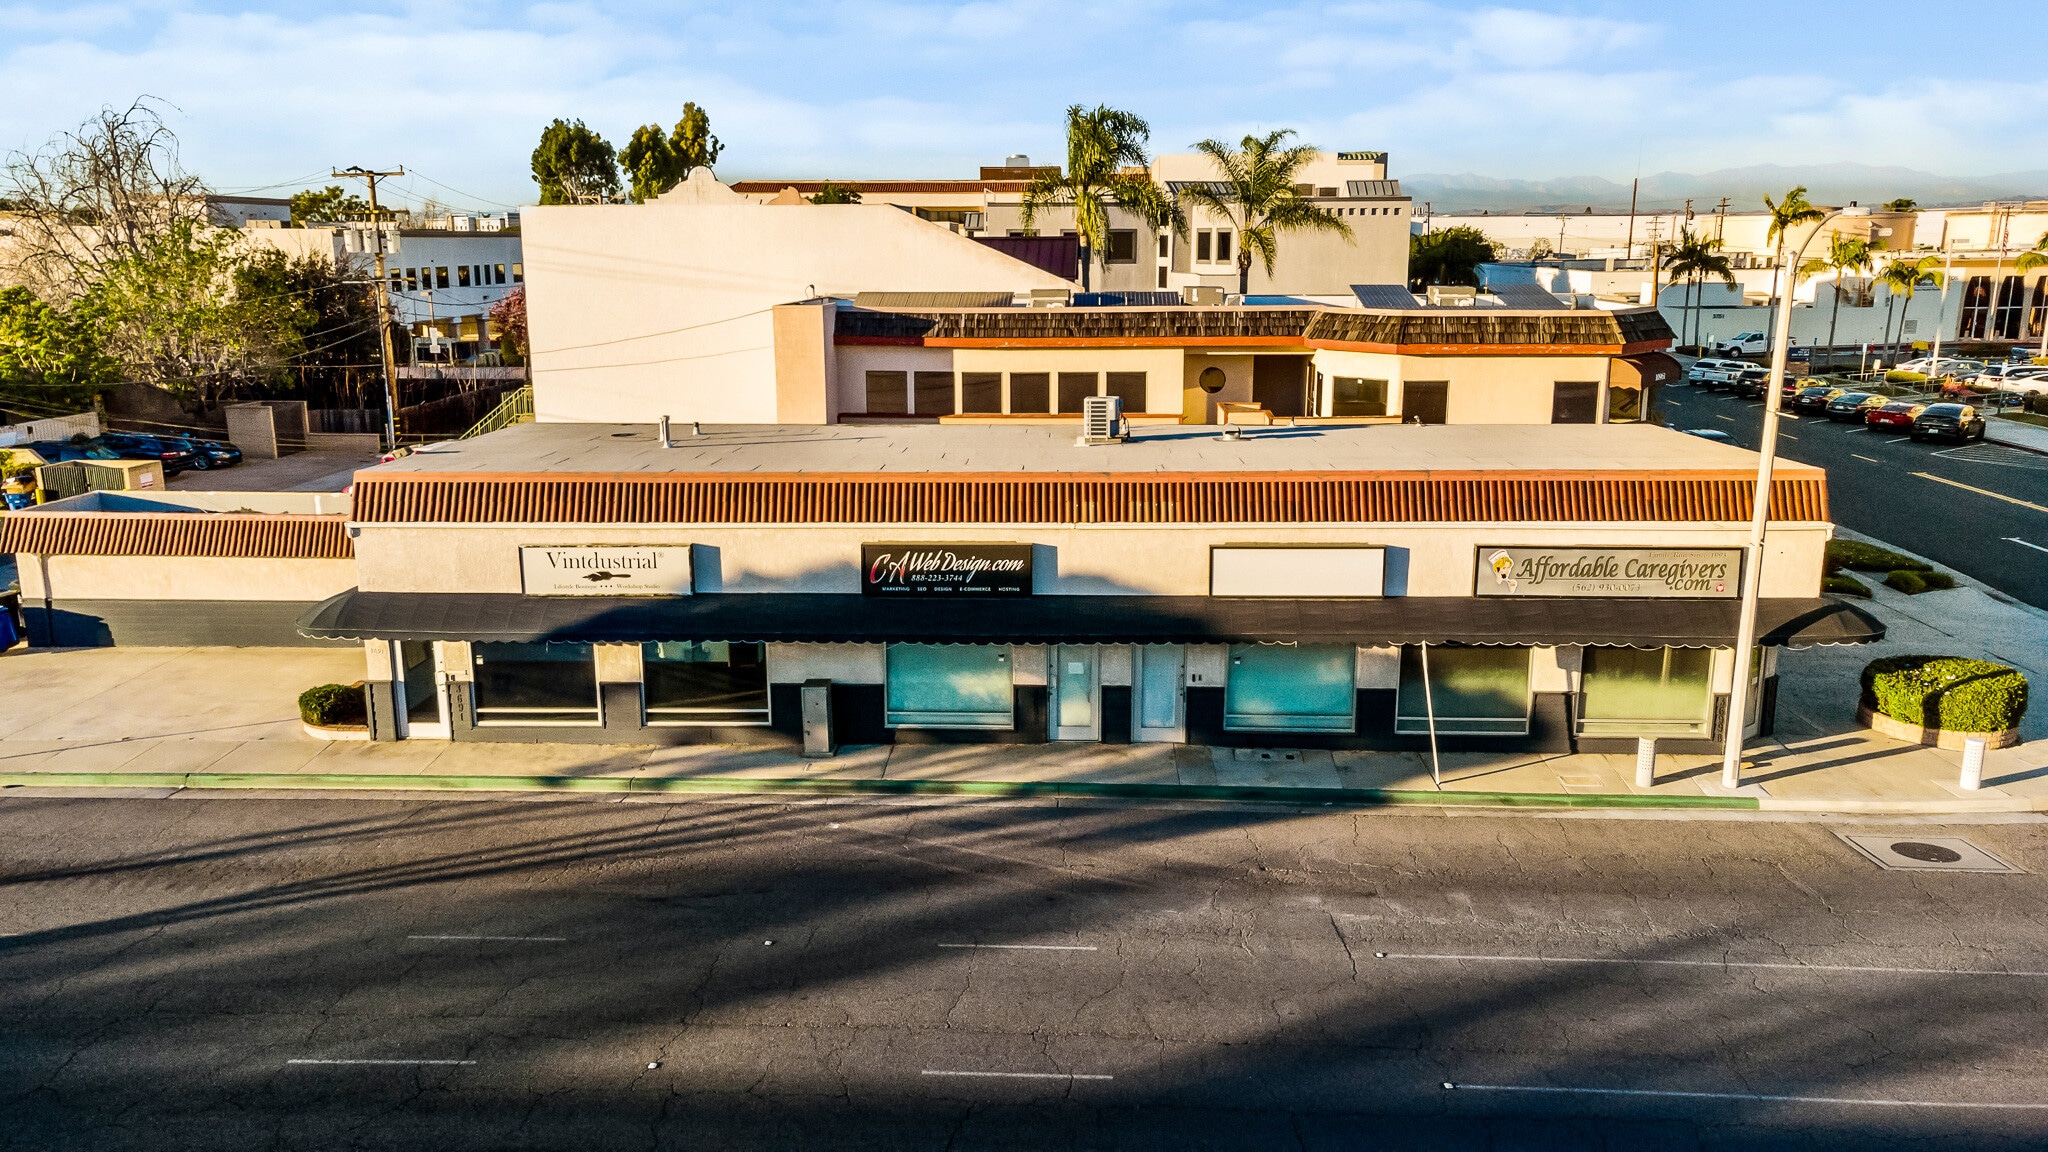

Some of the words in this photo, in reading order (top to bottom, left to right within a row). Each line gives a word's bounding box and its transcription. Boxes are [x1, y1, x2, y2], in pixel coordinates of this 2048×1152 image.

[1516, 556, 1618, 584] Affordable
[1624, 558, 1727, 585] Caregivers
[911, 574, 963, 582] 888-223-3744
[1572, 584, 1596, 592] (562)
[1669, 578, 1712, 590] .com
